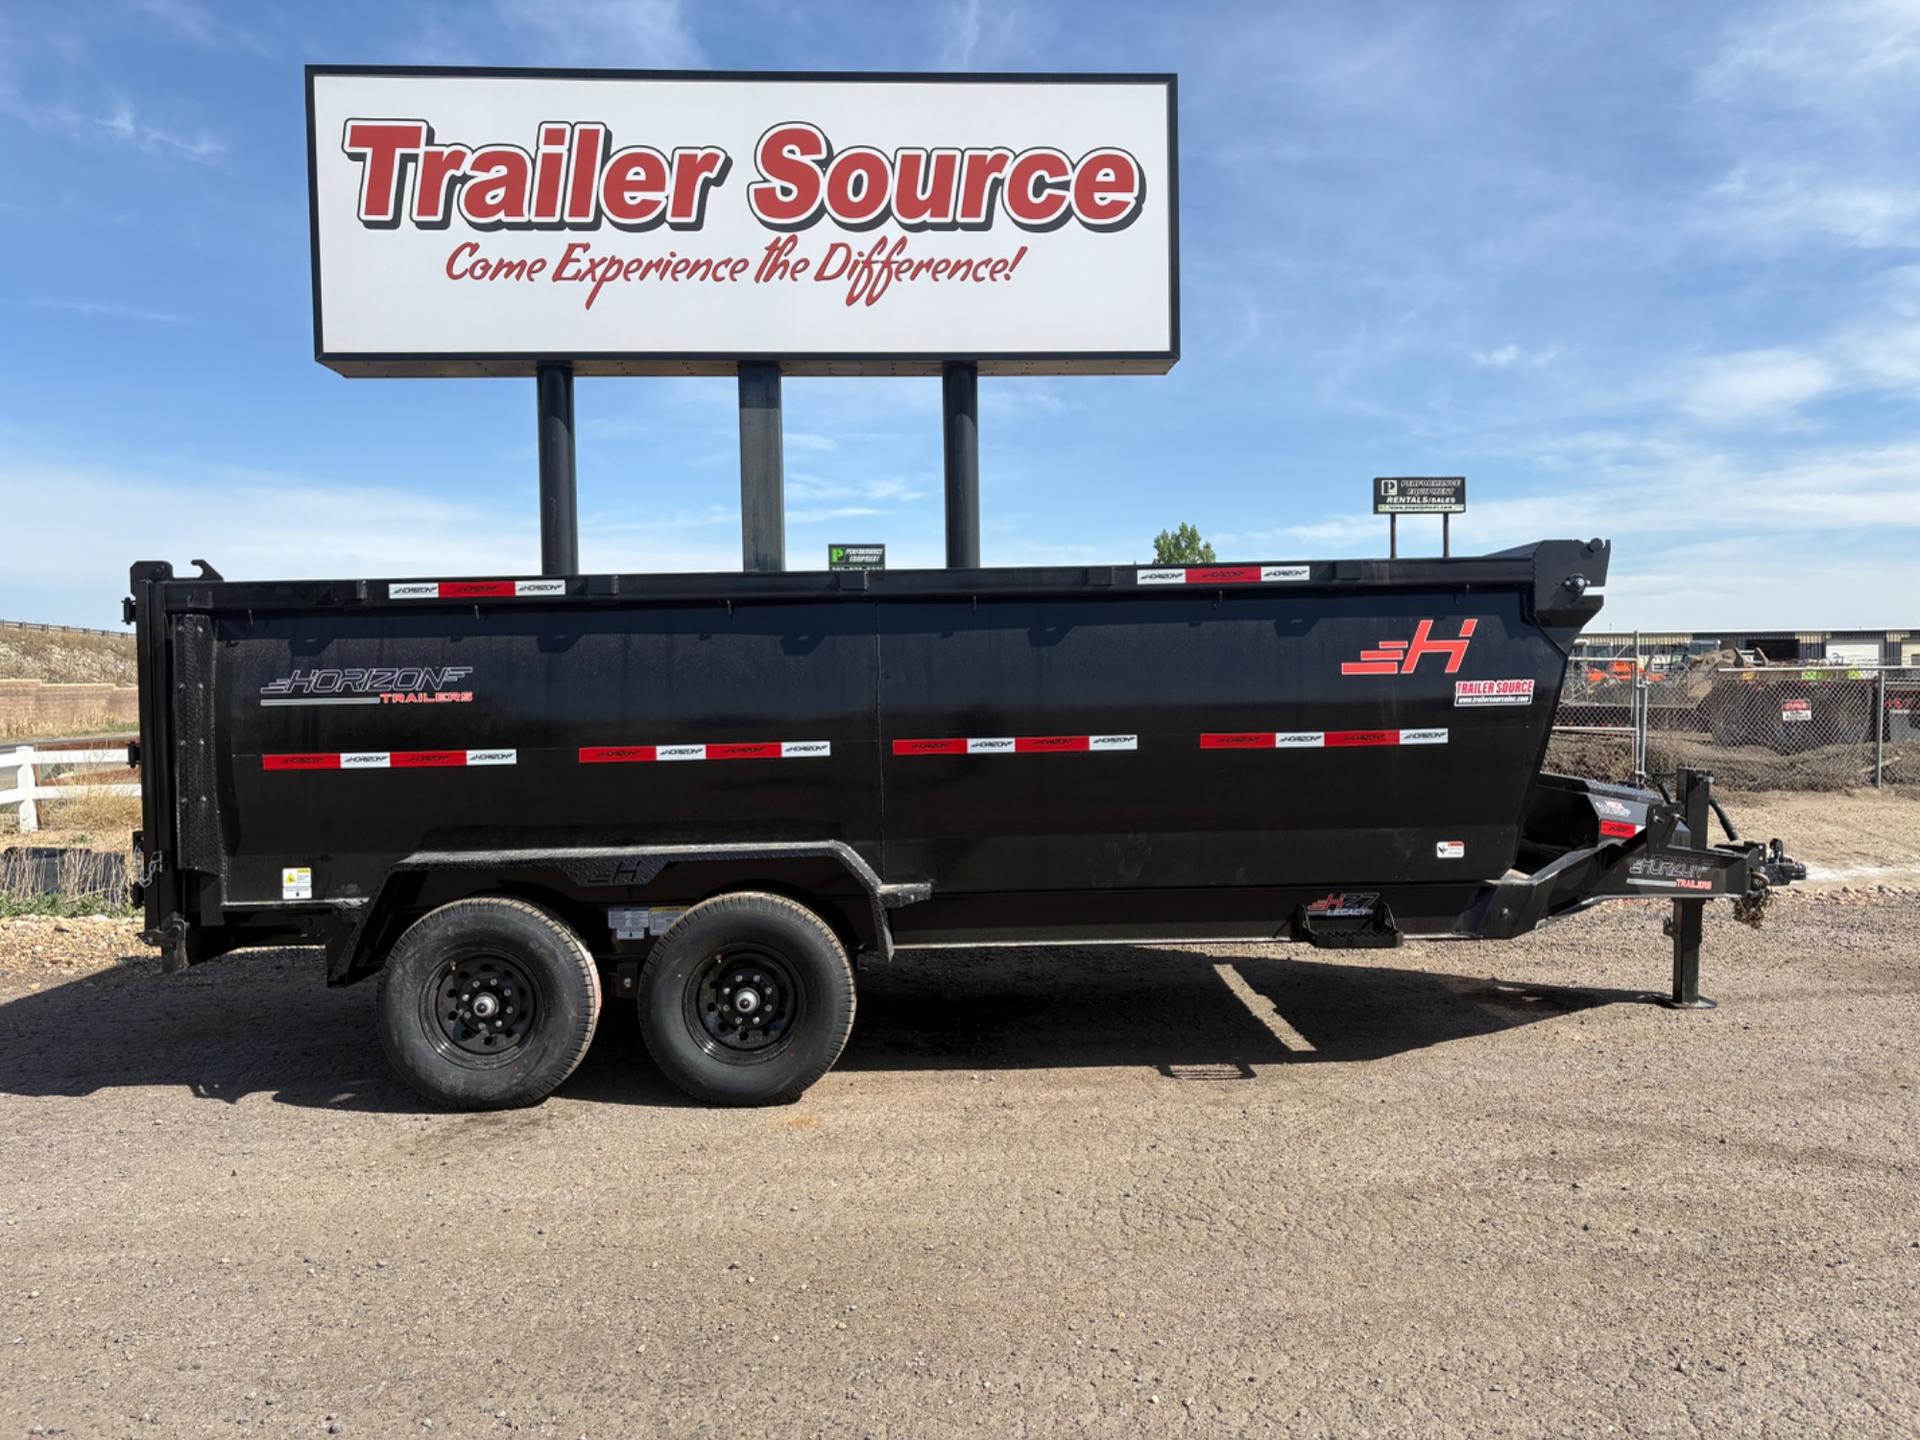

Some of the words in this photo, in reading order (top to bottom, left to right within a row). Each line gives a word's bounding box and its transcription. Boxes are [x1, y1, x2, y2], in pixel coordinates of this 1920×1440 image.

[342, 117, 733, 232] Trailer
[747, 121, 1147, 233] Source
[446, 242, 548, 281] Come
[552, 242, 749, 311] Experience
[755, 234, 810, 283] the
[814, 235, 1029, 307] Difference!
[1407, 488, 1456, 496] EQUIPMENT
[1386, 496, 1456, 504] RENTALS/SALES
[1264, 569, 1308, 577] HORIZON
[394, 586, 437, 594] HORIZON
[518, 584, 562, 592] HORIZON
[272, 666, 464, 694] HORIZON
[1456, 681, 1495, 694] TRAILER
[1496, 680, 1533, 693] SOURCE
[380, 692, 473, 704] TRAILERS
[971, 741, 1013, 749] HORIZON
[1093, 736, 1135, 744] HORIZON
[1279, 735, 1322, 743] HORIZON
[1404, 732, 1446, 740] HORIZON
[660, 748, 703, 756] HORIZON
[345, 755, 388, 763] HORIZON
[470, 753, 513, 761] HORIZON
[1675, 879, 1712, 890] TRAILERS
[1326, 908, 1368, 917] LEGACY
